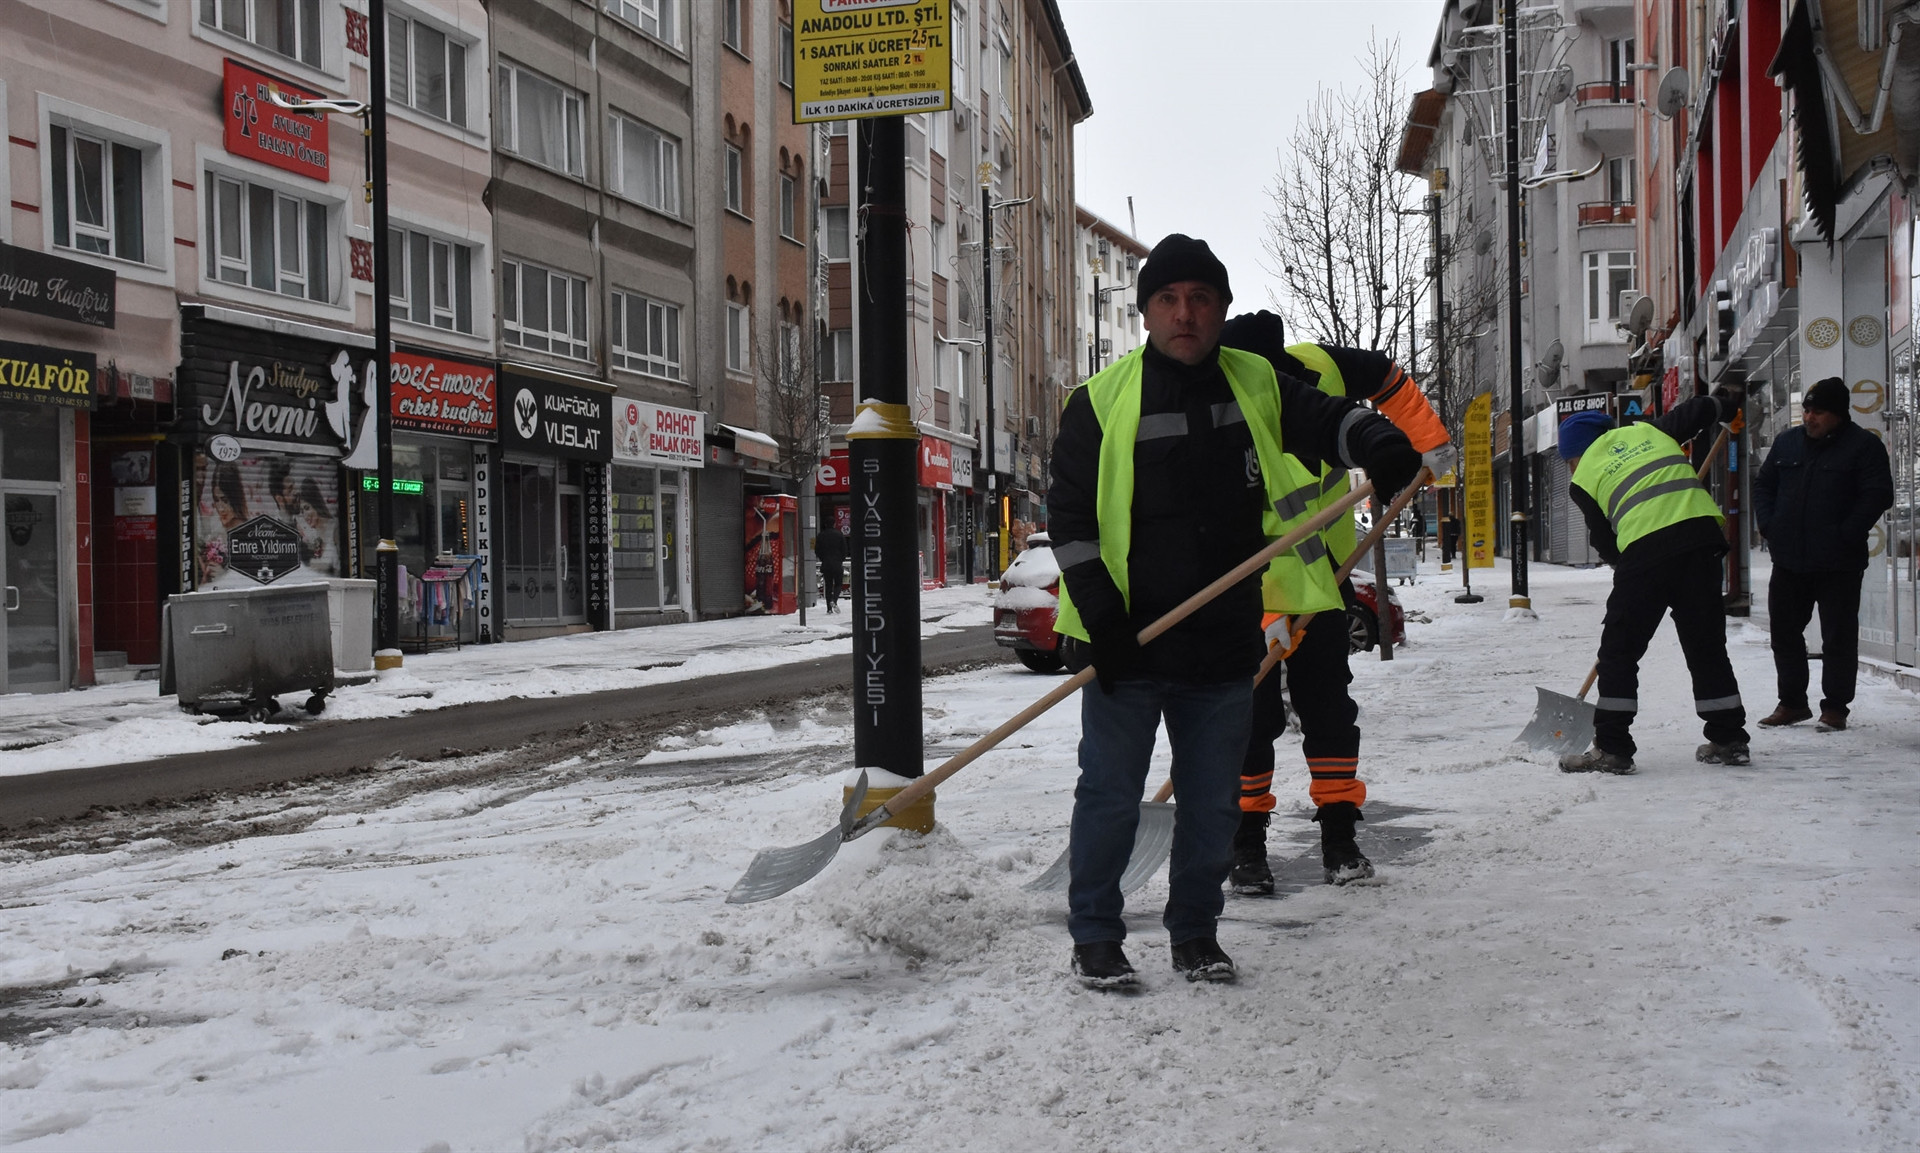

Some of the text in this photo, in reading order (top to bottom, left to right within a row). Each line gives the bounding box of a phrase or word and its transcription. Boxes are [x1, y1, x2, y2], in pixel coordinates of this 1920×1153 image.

[801, 4, 942, 34] ANADOLU LTD. ŞTİ.
[800, 48, 806, 60] 1
[811, 40, 864, 58] SAATLİK
[912, 29, 927, 47] 2,5
[928, 35, 942, 48] TL
[824, 60, 860, 72] SONRAKİ
[863, 57, 899, 69] SAATLER
[904, 54, 911, 64] 2
[830, 76, 842, 84] SAATİ
[882, 72, 894, 80] SAATİ
[806, 96, 940, 115] İLK 10 DAKİKA ÜCRETSİZDİR
[272, 114, 312, 140] AVUKAT
[258, 132, 327, 168] HAKAN ÖNER
[47, 278, 110, 314] Kuaförü
[0, 358, 89, 395] KUAFÖR
[268, 361, 320, 398] Stüdyo
[202, 360, 318, 438] Necmi
[399, 396, 493, 424] erkek kuaförü
[544, 394, 600, 418] KUAFÖRÜM
[1559, 398, 1605, 412] 2.EL CEP SHOP
[420, 422, 454, 432] modelde
[544, 420, 600, 450] VUSLAT
[656, 409, 696, 436] RAHAT
[650, 433, 700, 456] EMLAK OFİSİ
[1608, 462, 1623, 476] PLAN
[248, 524, 277, 538] Necmi
[232, 539, 297, 554] Emre Yıldırım
[864, 459, 885, 726] SİVAS BELEDİYESİ
